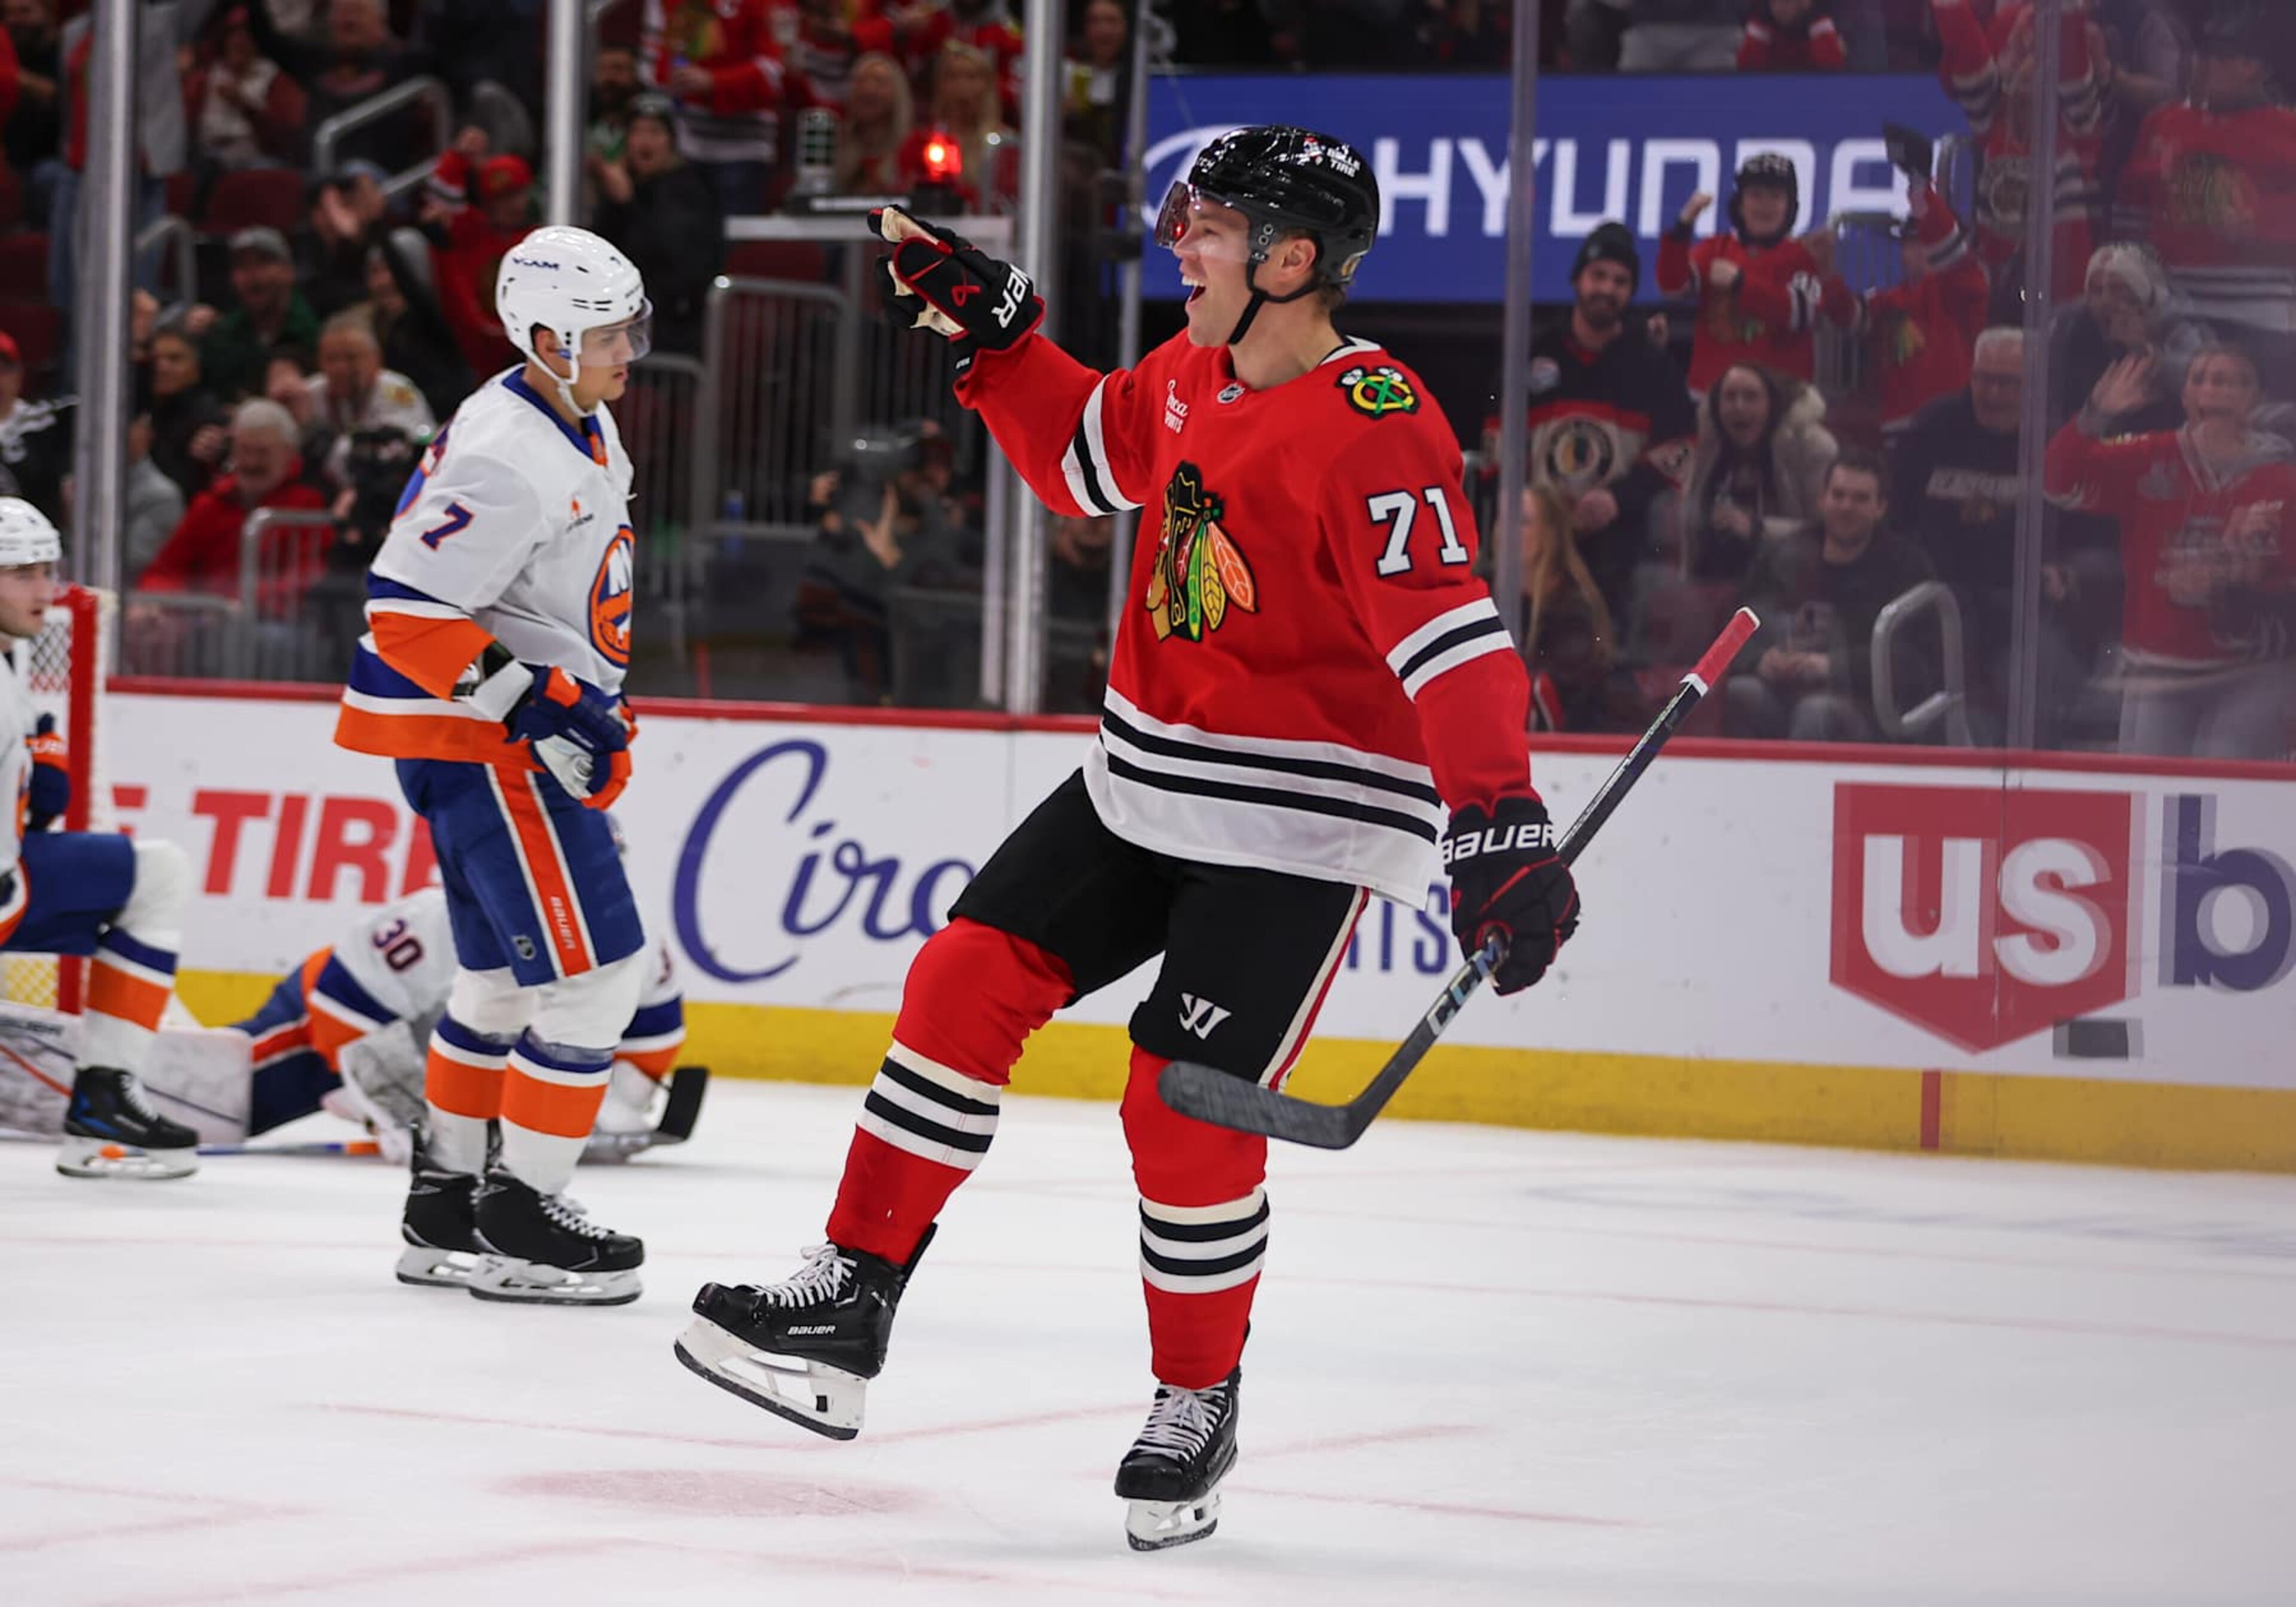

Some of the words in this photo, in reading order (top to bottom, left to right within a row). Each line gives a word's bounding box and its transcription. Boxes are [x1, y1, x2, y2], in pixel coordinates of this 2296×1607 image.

[1375, 137, 1941, 237] HYUNDA
[420, 501, 474, 552] 7
[1366, 488, 1469, 579] 71
[673, 740, 975, 982] Circ
[371, 918, 423, 971] 30
[1860, 833, 2112, 986] us
[787, 1325, 836, 1336] BAUER
